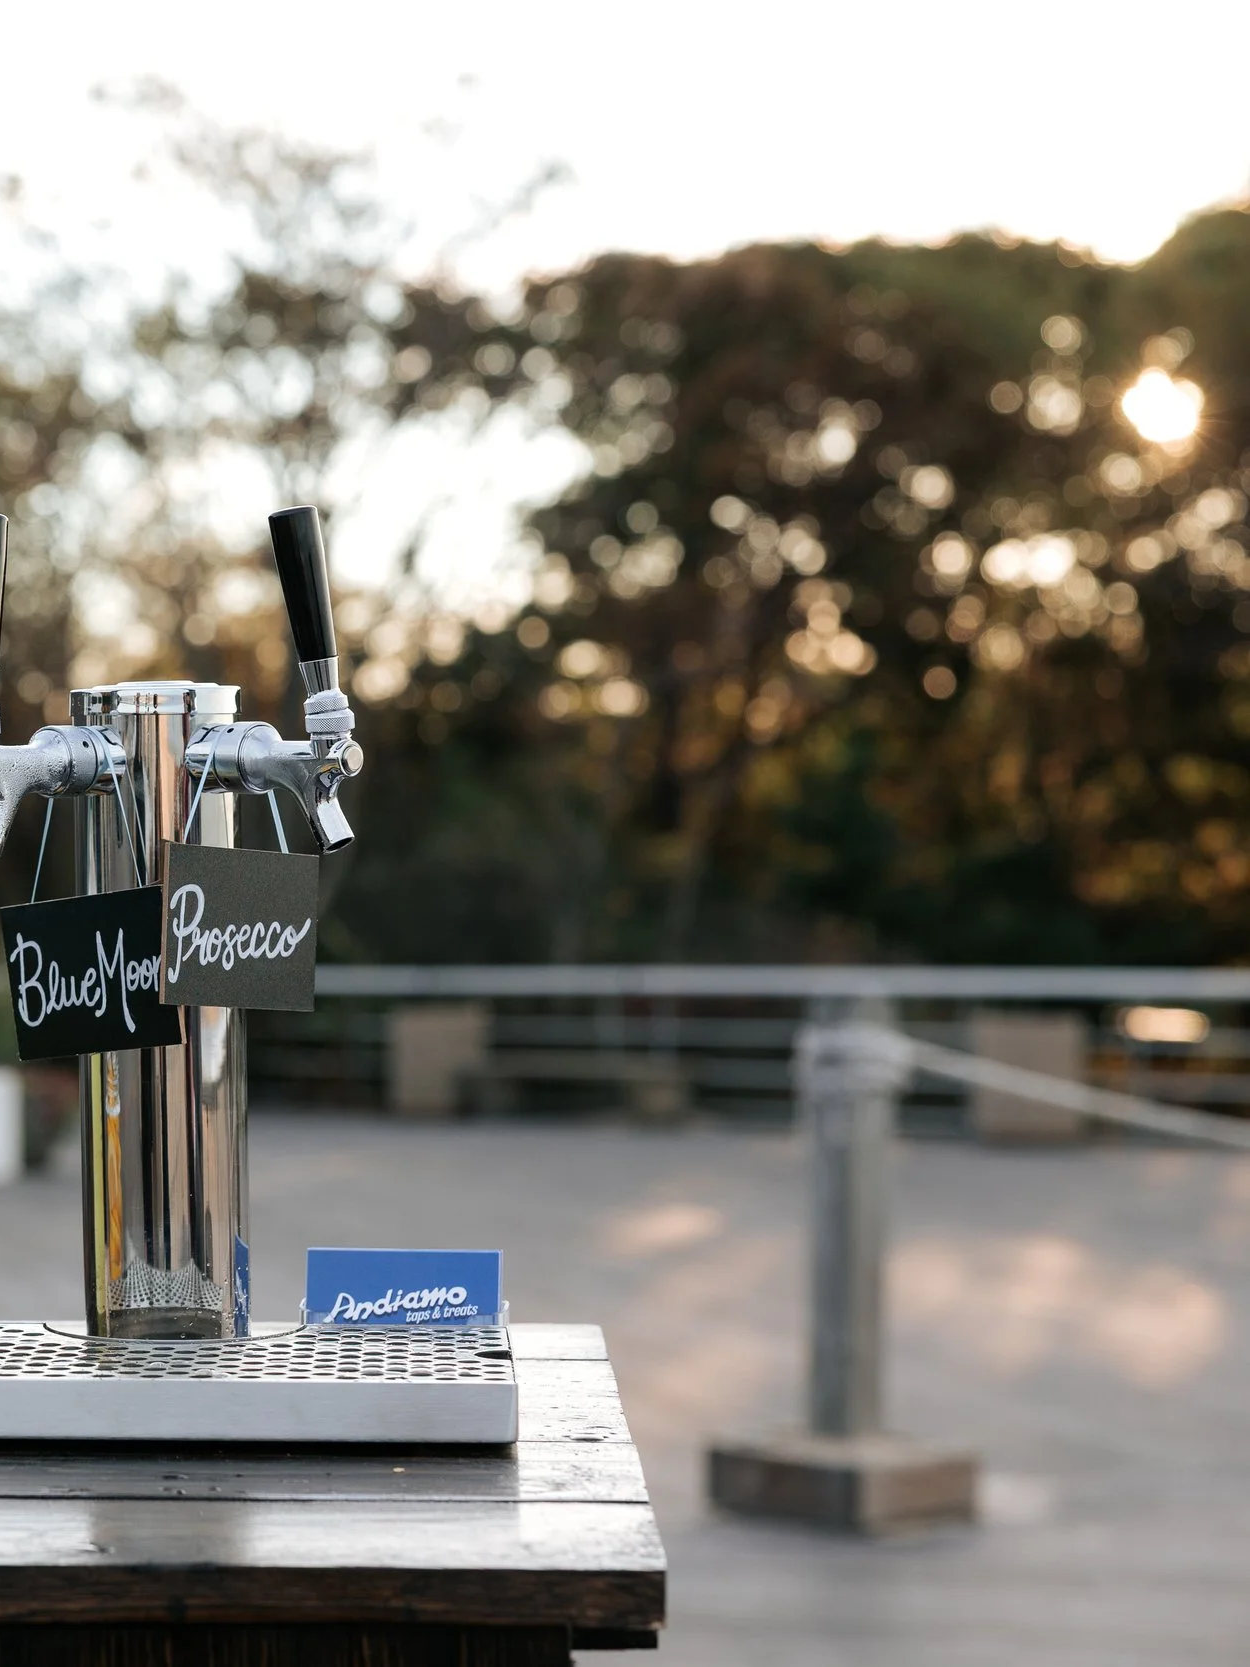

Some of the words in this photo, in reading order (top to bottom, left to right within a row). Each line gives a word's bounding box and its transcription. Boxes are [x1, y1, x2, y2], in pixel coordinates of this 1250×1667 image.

[168, 883, 311, 983] Prosecco
[10, 932, 101, 1027] Blue
[323, 1286, 468, 1323] Andiamo
[405, 1309, 430, 1324] taps
[432, 1306, 441, 1318] &
[444, 1304, 479, 1318] treats
